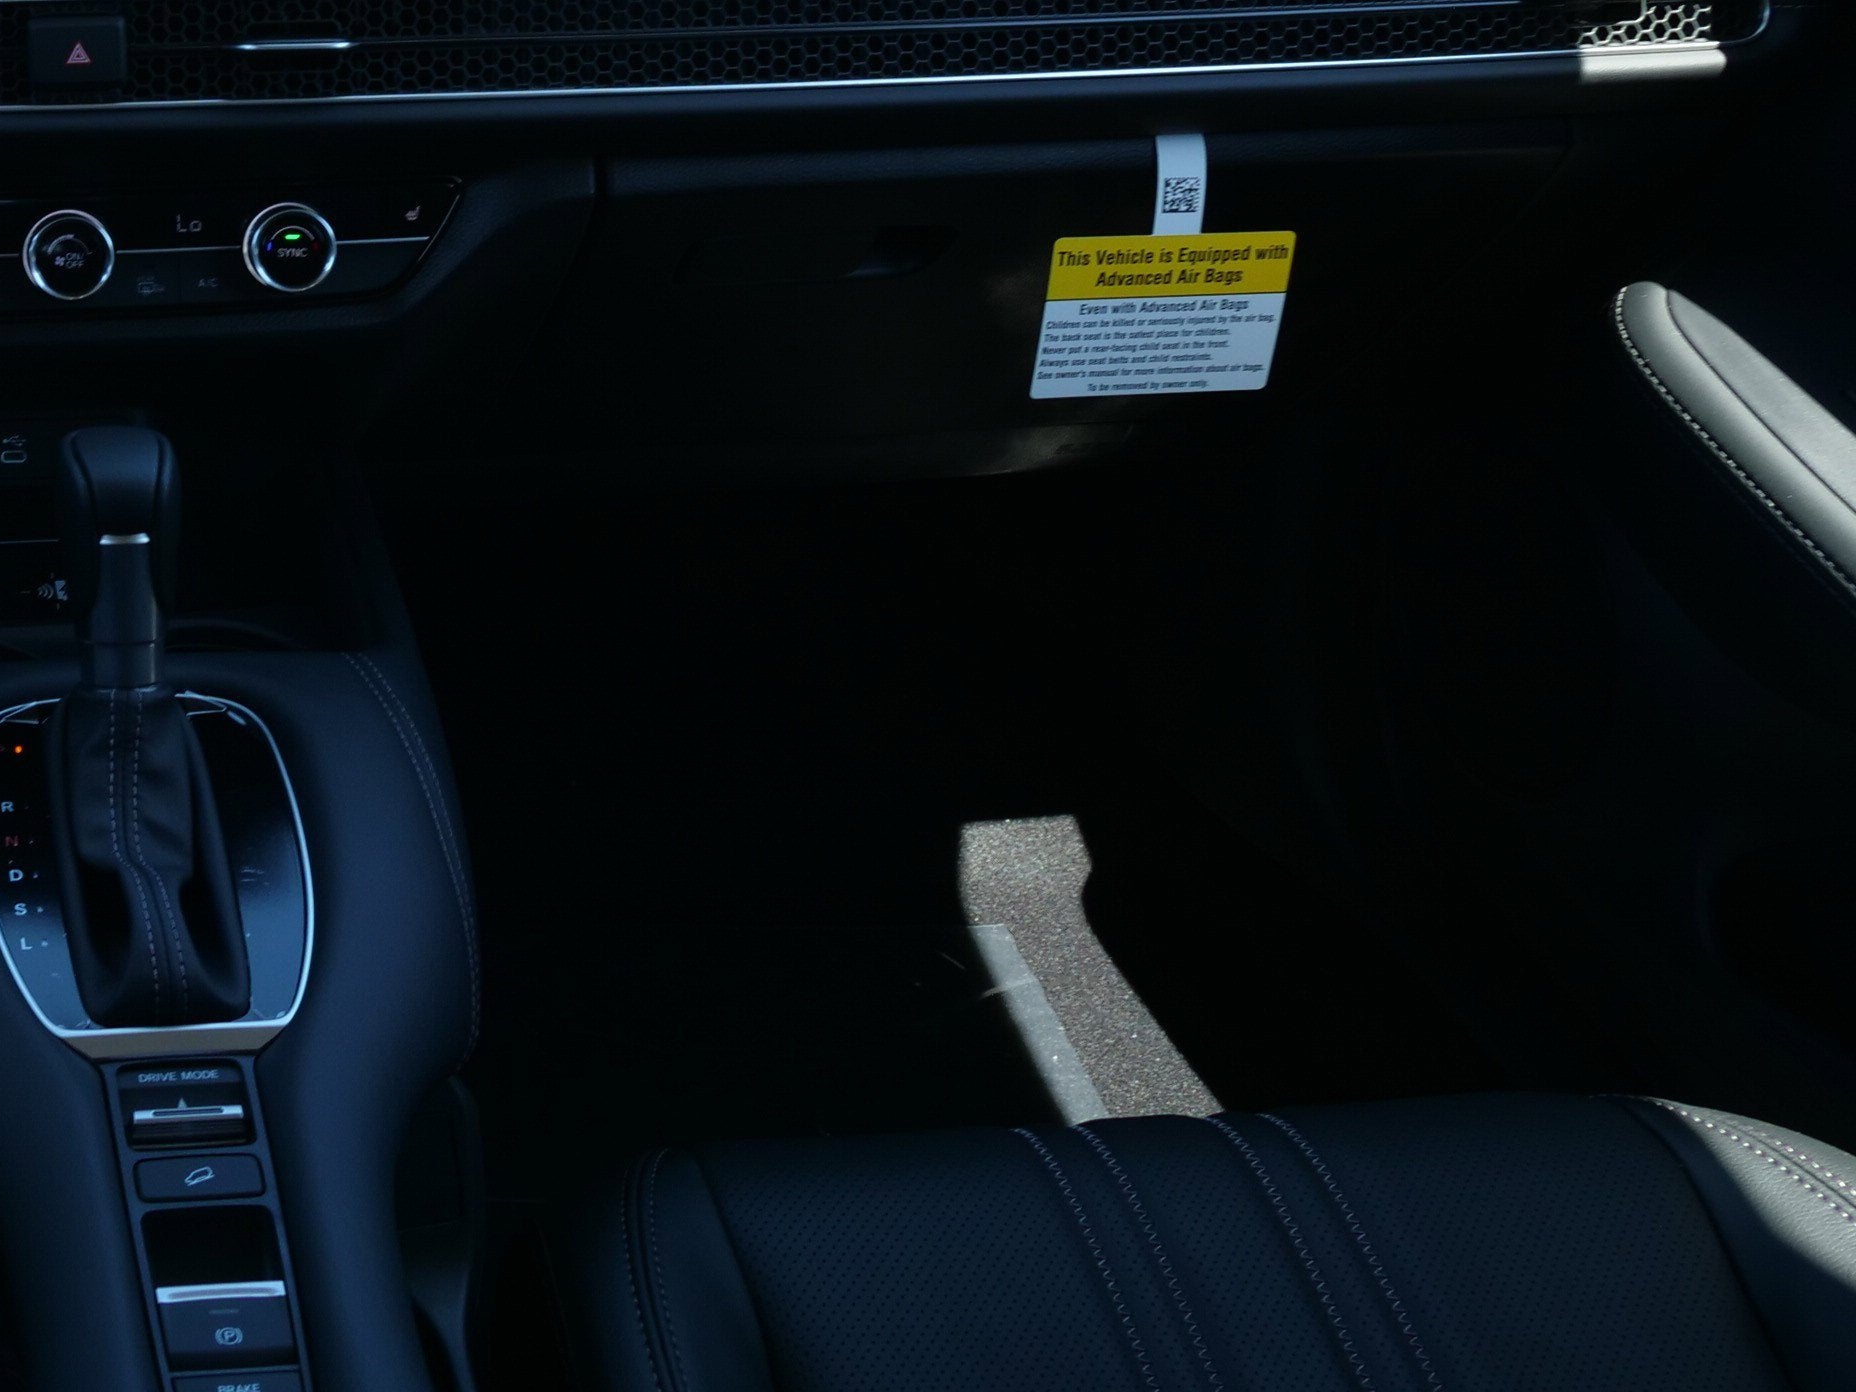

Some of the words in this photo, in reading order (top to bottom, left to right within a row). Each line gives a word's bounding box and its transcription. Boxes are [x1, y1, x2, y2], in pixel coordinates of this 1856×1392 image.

[276, 247, 309, 258] SYNC
[1058, 251, 1090, 266] This
[1095, 249, 1154, 265] Vehicle
[1159, 248, 1174, 264] is
[1178, 245, 1251, 266] Equipped
[1254, 244, 1289, 260] with
[1095, 270, 1172, 287] Advanced
[1176, 269, 1201, 284] Air
[1205, 268, 1243, 285] Bags
[1078, 304, 1108, 315] Even
[1110, 302, 1137, 313] with
[1138, 300, 1197, 313] Advanced
[1199, 300, 1217, 310] Air
[1219, 299, 1249, 312] Bags
[0, 800, 15, 813] R
[5, 836, 19, 847] N
[9, 869, 23, 882] D
[14, 903, 27, 915] S
[21, 937, 33, 950] L
[137, 1071, 178, 1083] DRIVE
[181, 1070, 220, 1080] MODE
